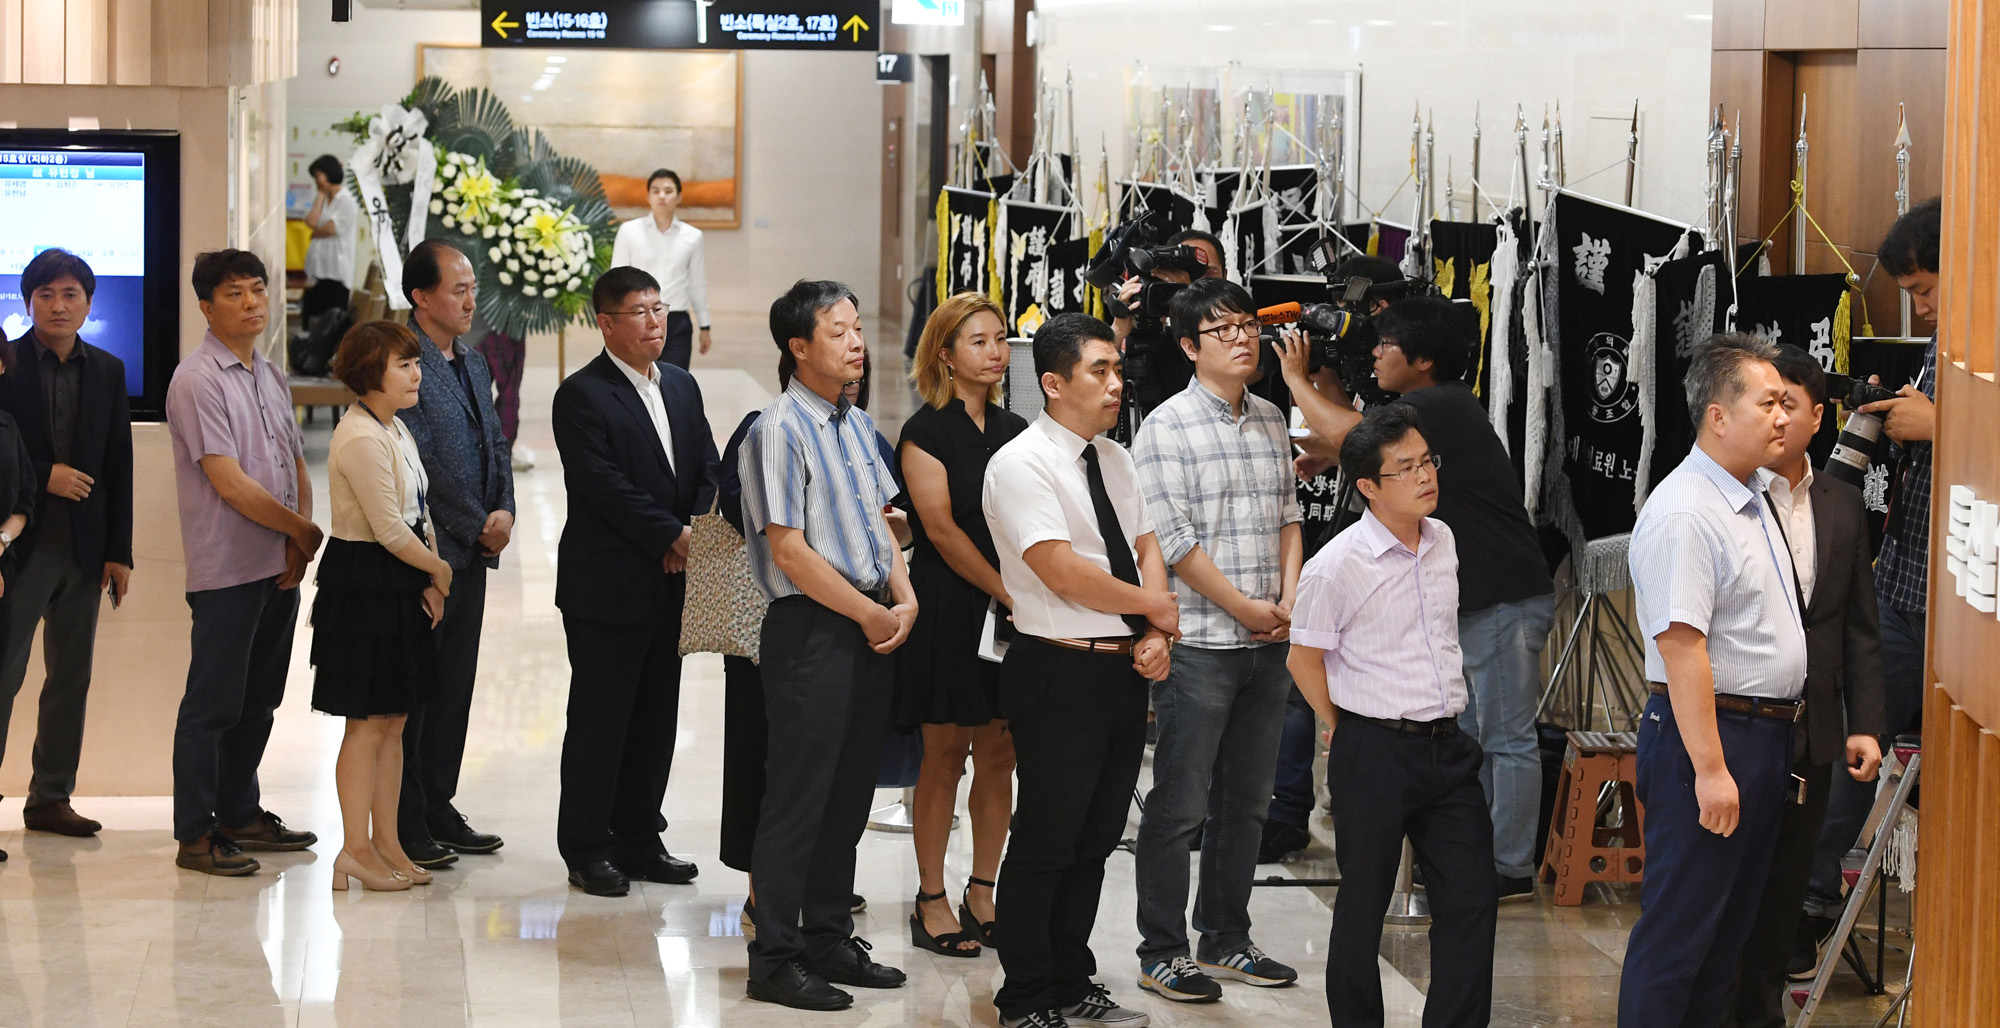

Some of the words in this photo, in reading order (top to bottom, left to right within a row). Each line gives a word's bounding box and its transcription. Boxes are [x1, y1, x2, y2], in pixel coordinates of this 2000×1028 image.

[805, 14, 838, 32] 17호)
[877, 54, 898, 73] 17
[1573, 232, 1612, 295] 謹
[1863, 462, 1889, 514] 謹
